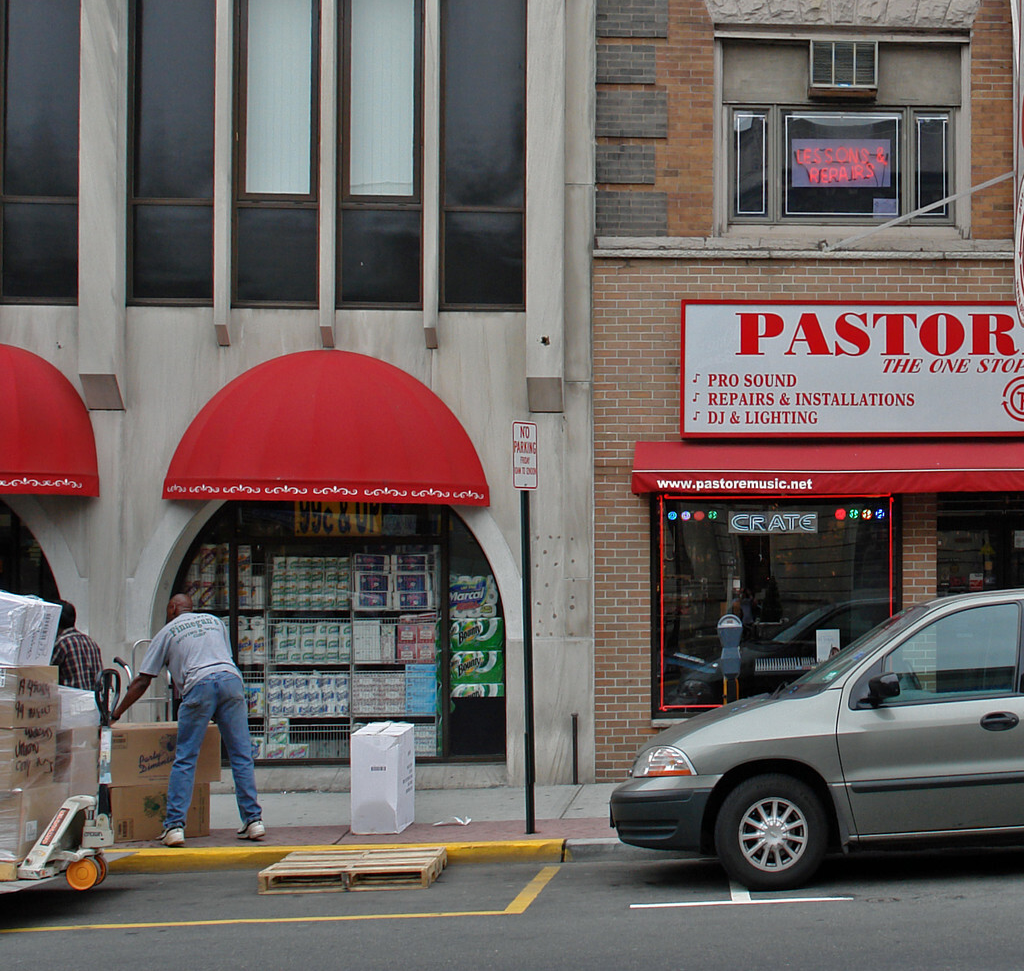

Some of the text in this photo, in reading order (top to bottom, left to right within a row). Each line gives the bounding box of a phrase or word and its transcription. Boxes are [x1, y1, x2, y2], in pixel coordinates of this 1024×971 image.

[796, 147, 888, 165] LESSONS &
[809, 163, 875, 183] REPAIRS
[881, 358, 921, 374] THE
[929, 358, 970, 374] ONE
[707, 373, 797, 388] PRO SOUND
[707, 392, 915, 407] REPAIRS & INSTALLATIONS
[707, 410, 818, 426] DJ & LIGHTING
[519, 426, 530, 439] NO
[514, 440, 537, 455] PARKING
[657, 477, 813, 491] www.pastoremusic.net
[355, 501, 380, 533] UP
[731, 514, 816, 531] CRATE
[458, 625, 481, 644] Bounty
[458, 657, 481, 676] Bounty
